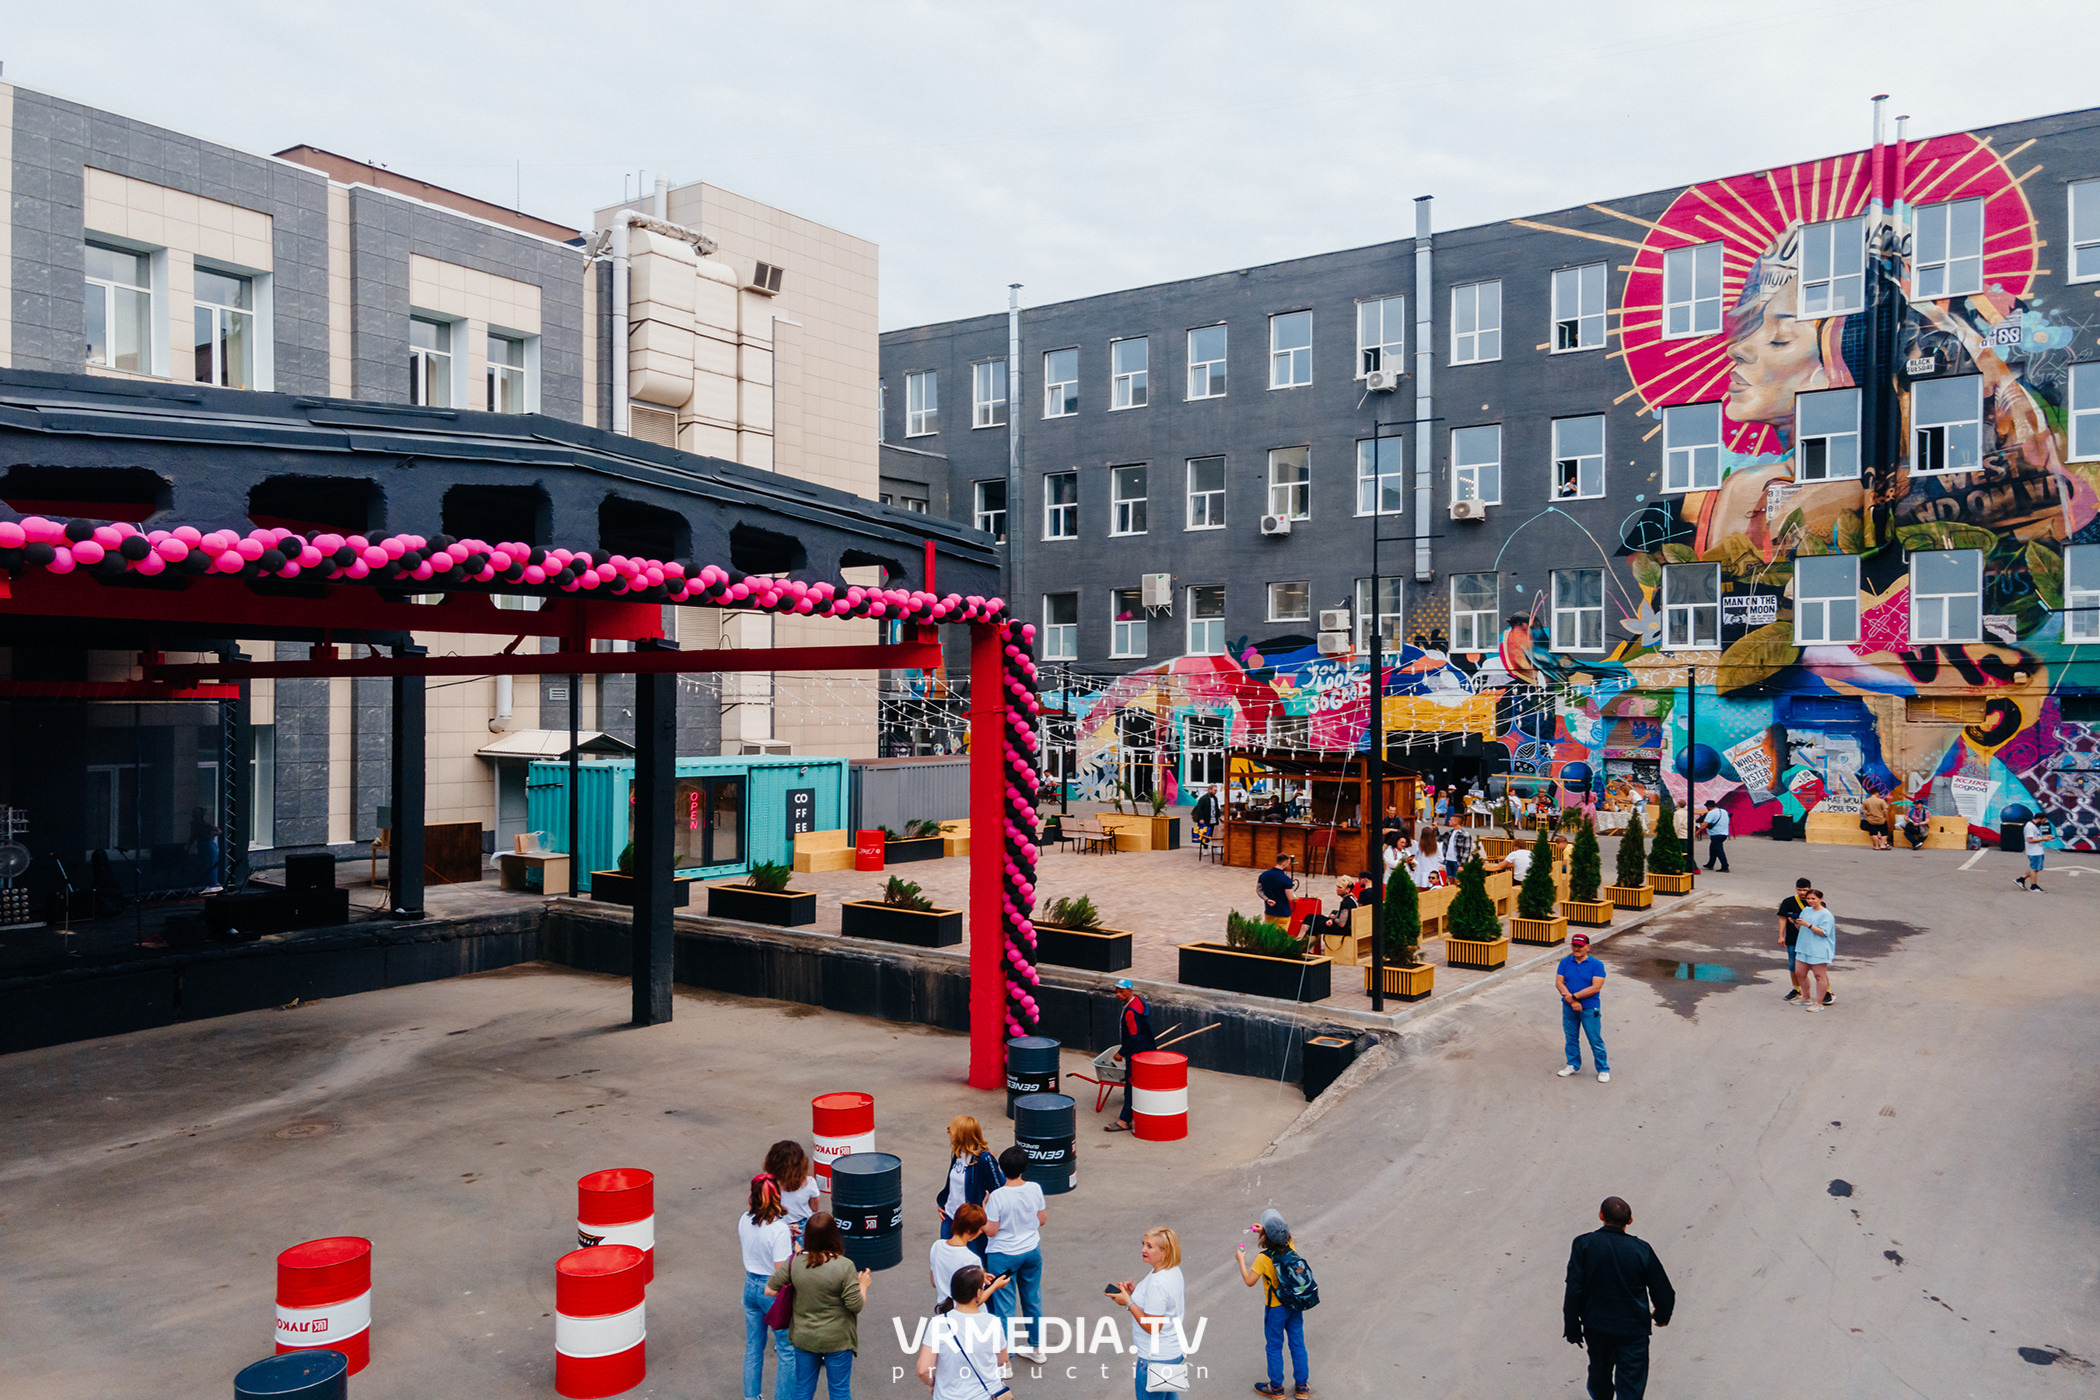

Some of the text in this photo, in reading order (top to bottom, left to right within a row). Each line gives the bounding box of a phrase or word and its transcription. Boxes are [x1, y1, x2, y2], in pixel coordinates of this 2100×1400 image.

[1910, 358, 1930, 367] BLACK
[1907, 365, 1933, 373] TUESDAY
[1936, 451, 2020, 493] WEST
[1724, 596, 1775, 606] MAN ON THE
[1750, 605, 1776, 614] MOON
[1301, 661, 1339, 688] YOU
[1316, 666, 1370, 693] LOOK
[1734, 754, 1753, 767] WHO
[1741, 763, 1759, 773] JACK
[794, 793, 808, 804] CO
[1843, 795, 1863, 804] WOUL
[690, 791, 699, 830] OPEN
[796, 808, 807, 818] FF
[795, 822, 807, 832] EE
[834, 1217, 852, 1230] GE
[277, 1318, 311, 1332] ЛУКО
